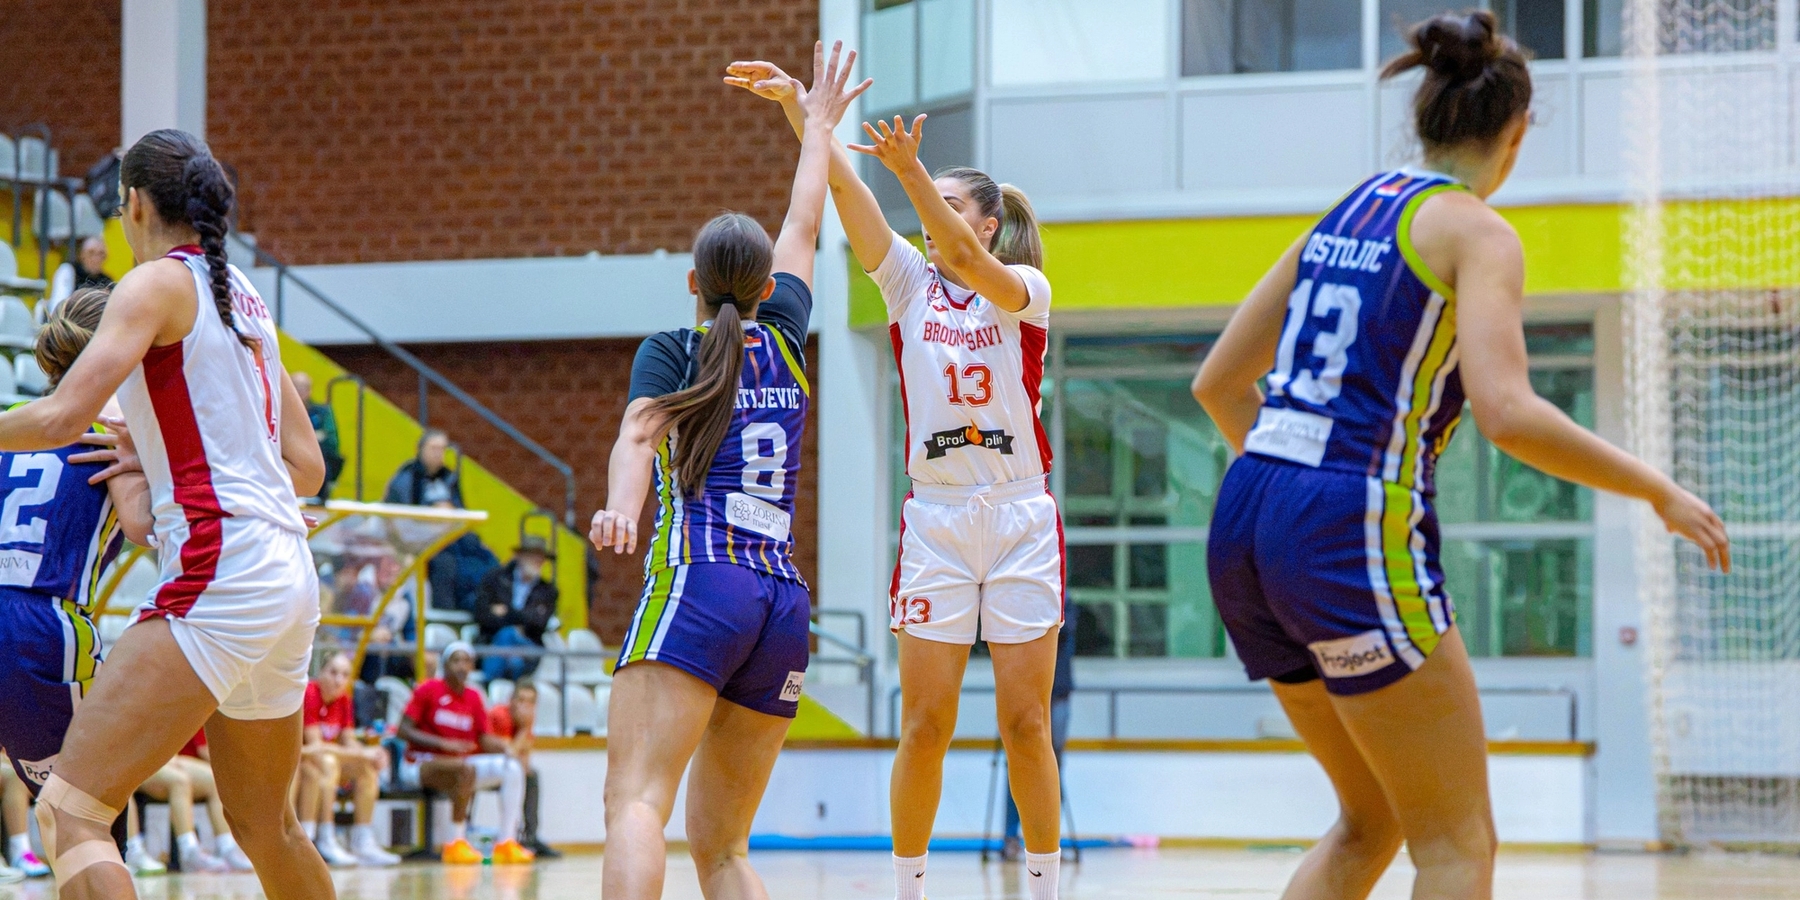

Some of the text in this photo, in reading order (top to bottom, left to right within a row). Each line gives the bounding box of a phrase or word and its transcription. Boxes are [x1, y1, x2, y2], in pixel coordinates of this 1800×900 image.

[1302, 232, 1392, 273] OSTOJIĆ
[965, 323, 1003, 351] SAVI
[1267, 279, 1362, 405] 13
[733, 383, 800, 409] ATIJEVIĆ
[943, 362, 994, 408] 13
[936, 432, 1003, 448] Brod plin
[740, 422, 788, 501] 8
[0, 453, 64, 544] 2
[752, 504, 788, 530] ZORINA
[0, 556, 30, 570] RINA
[899, 596, 932, 626] 13
